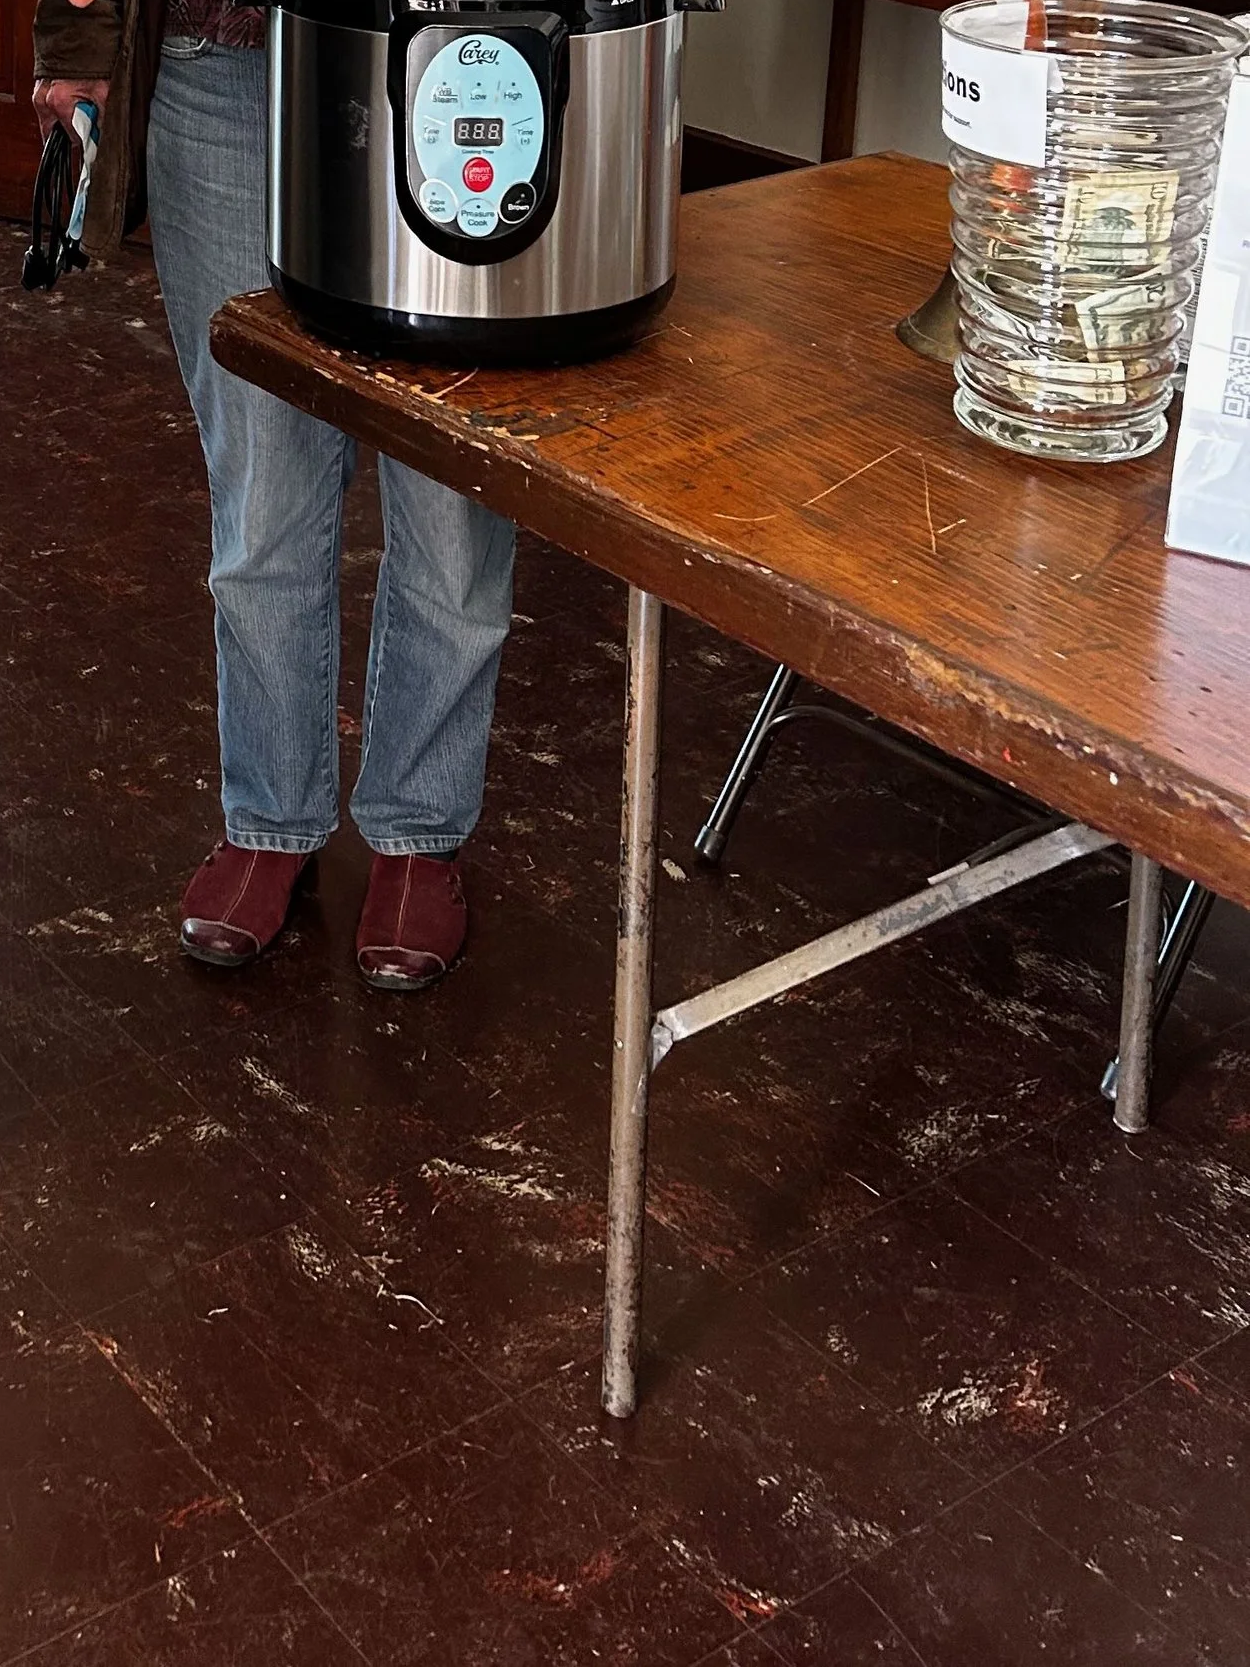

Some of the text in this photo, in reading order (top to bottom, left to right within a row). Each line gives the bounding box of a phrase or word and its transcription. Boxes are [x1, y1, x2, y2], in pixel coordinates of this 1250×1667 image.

[458, 39, 500, 66] Carey
[470, 93, 487, 101] Low
[503, 92, 523, 101] High
[467, 219, 488, 227] Cook
